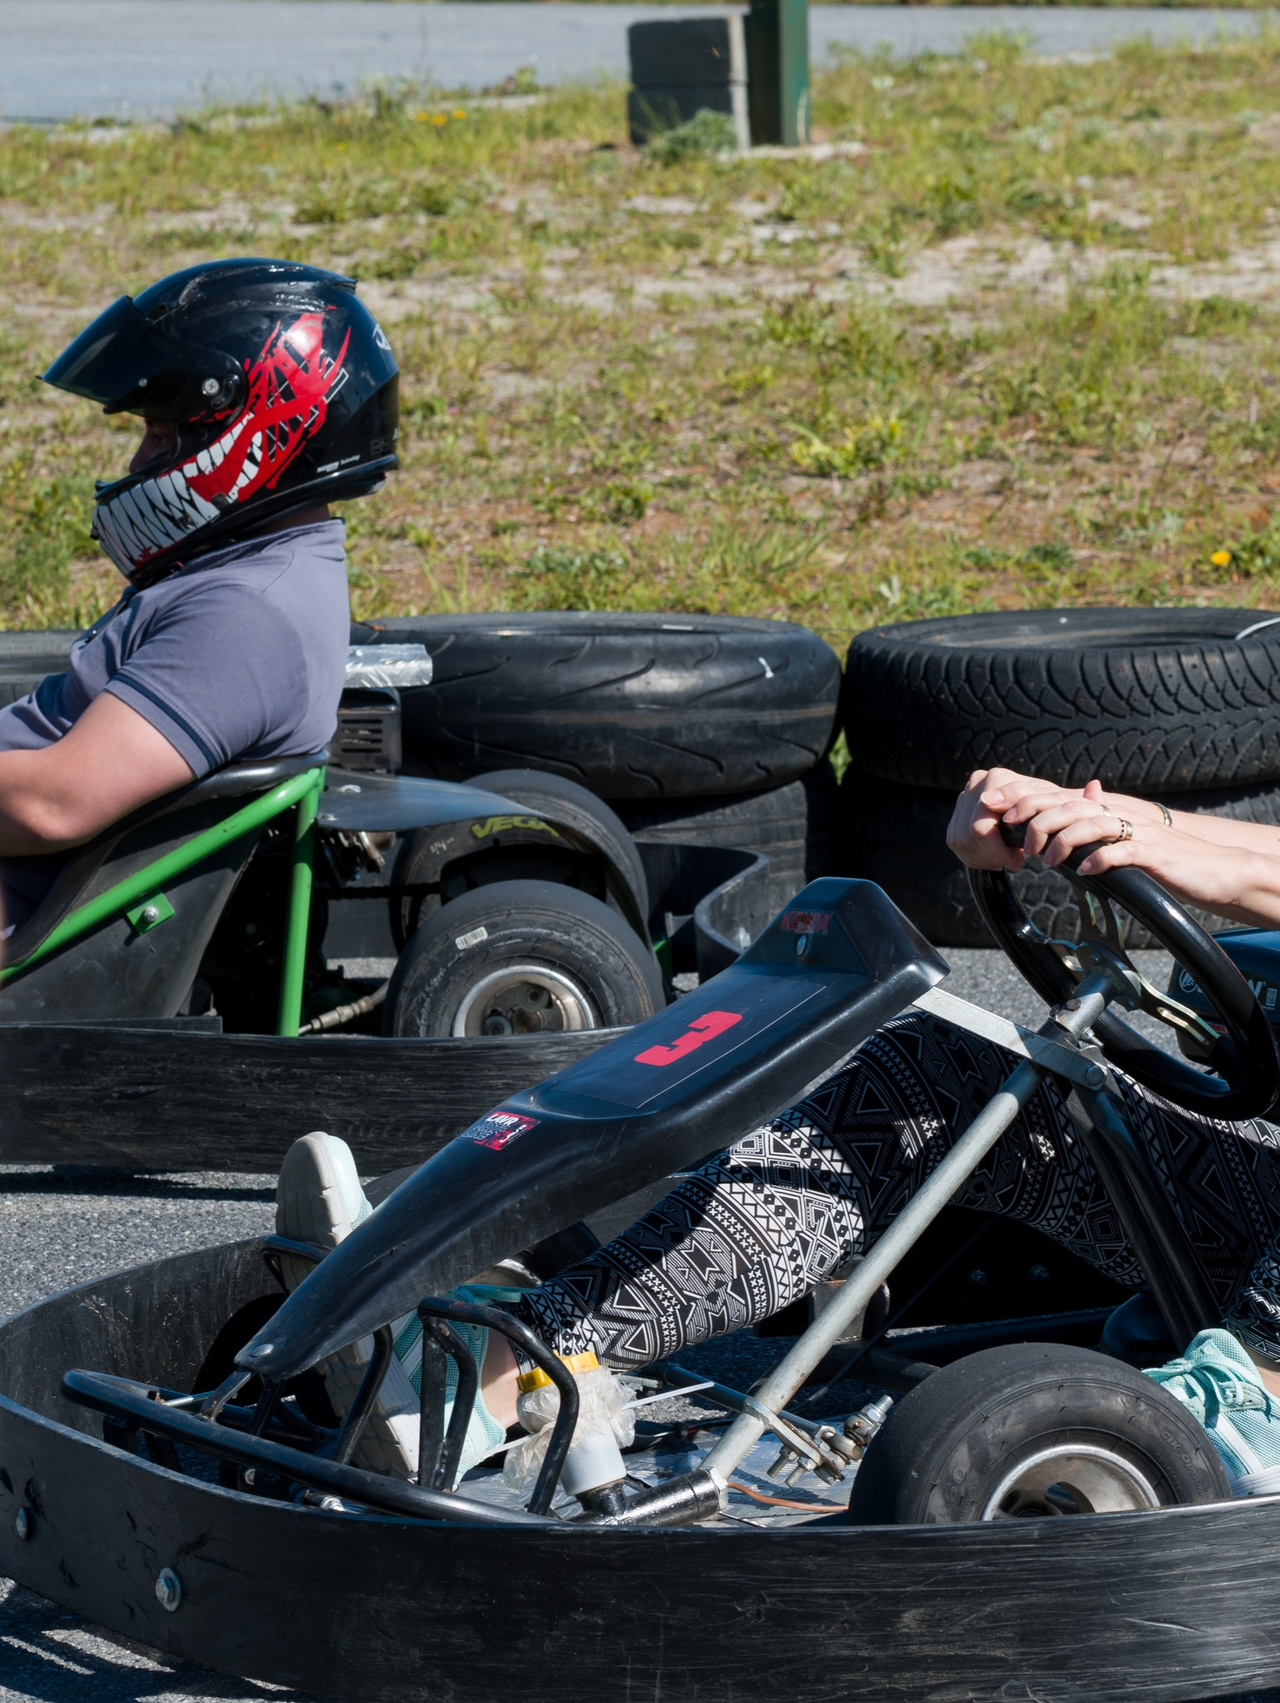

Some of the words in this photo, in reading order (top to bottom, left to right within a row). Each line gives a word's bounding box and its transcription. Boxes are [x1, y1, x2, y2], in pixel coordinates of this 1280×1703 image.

[780, 909, 831, 933] KENDA
[633, 1010, 743, 1067] 3
[485, 1112, 520, 1126] LAVR
